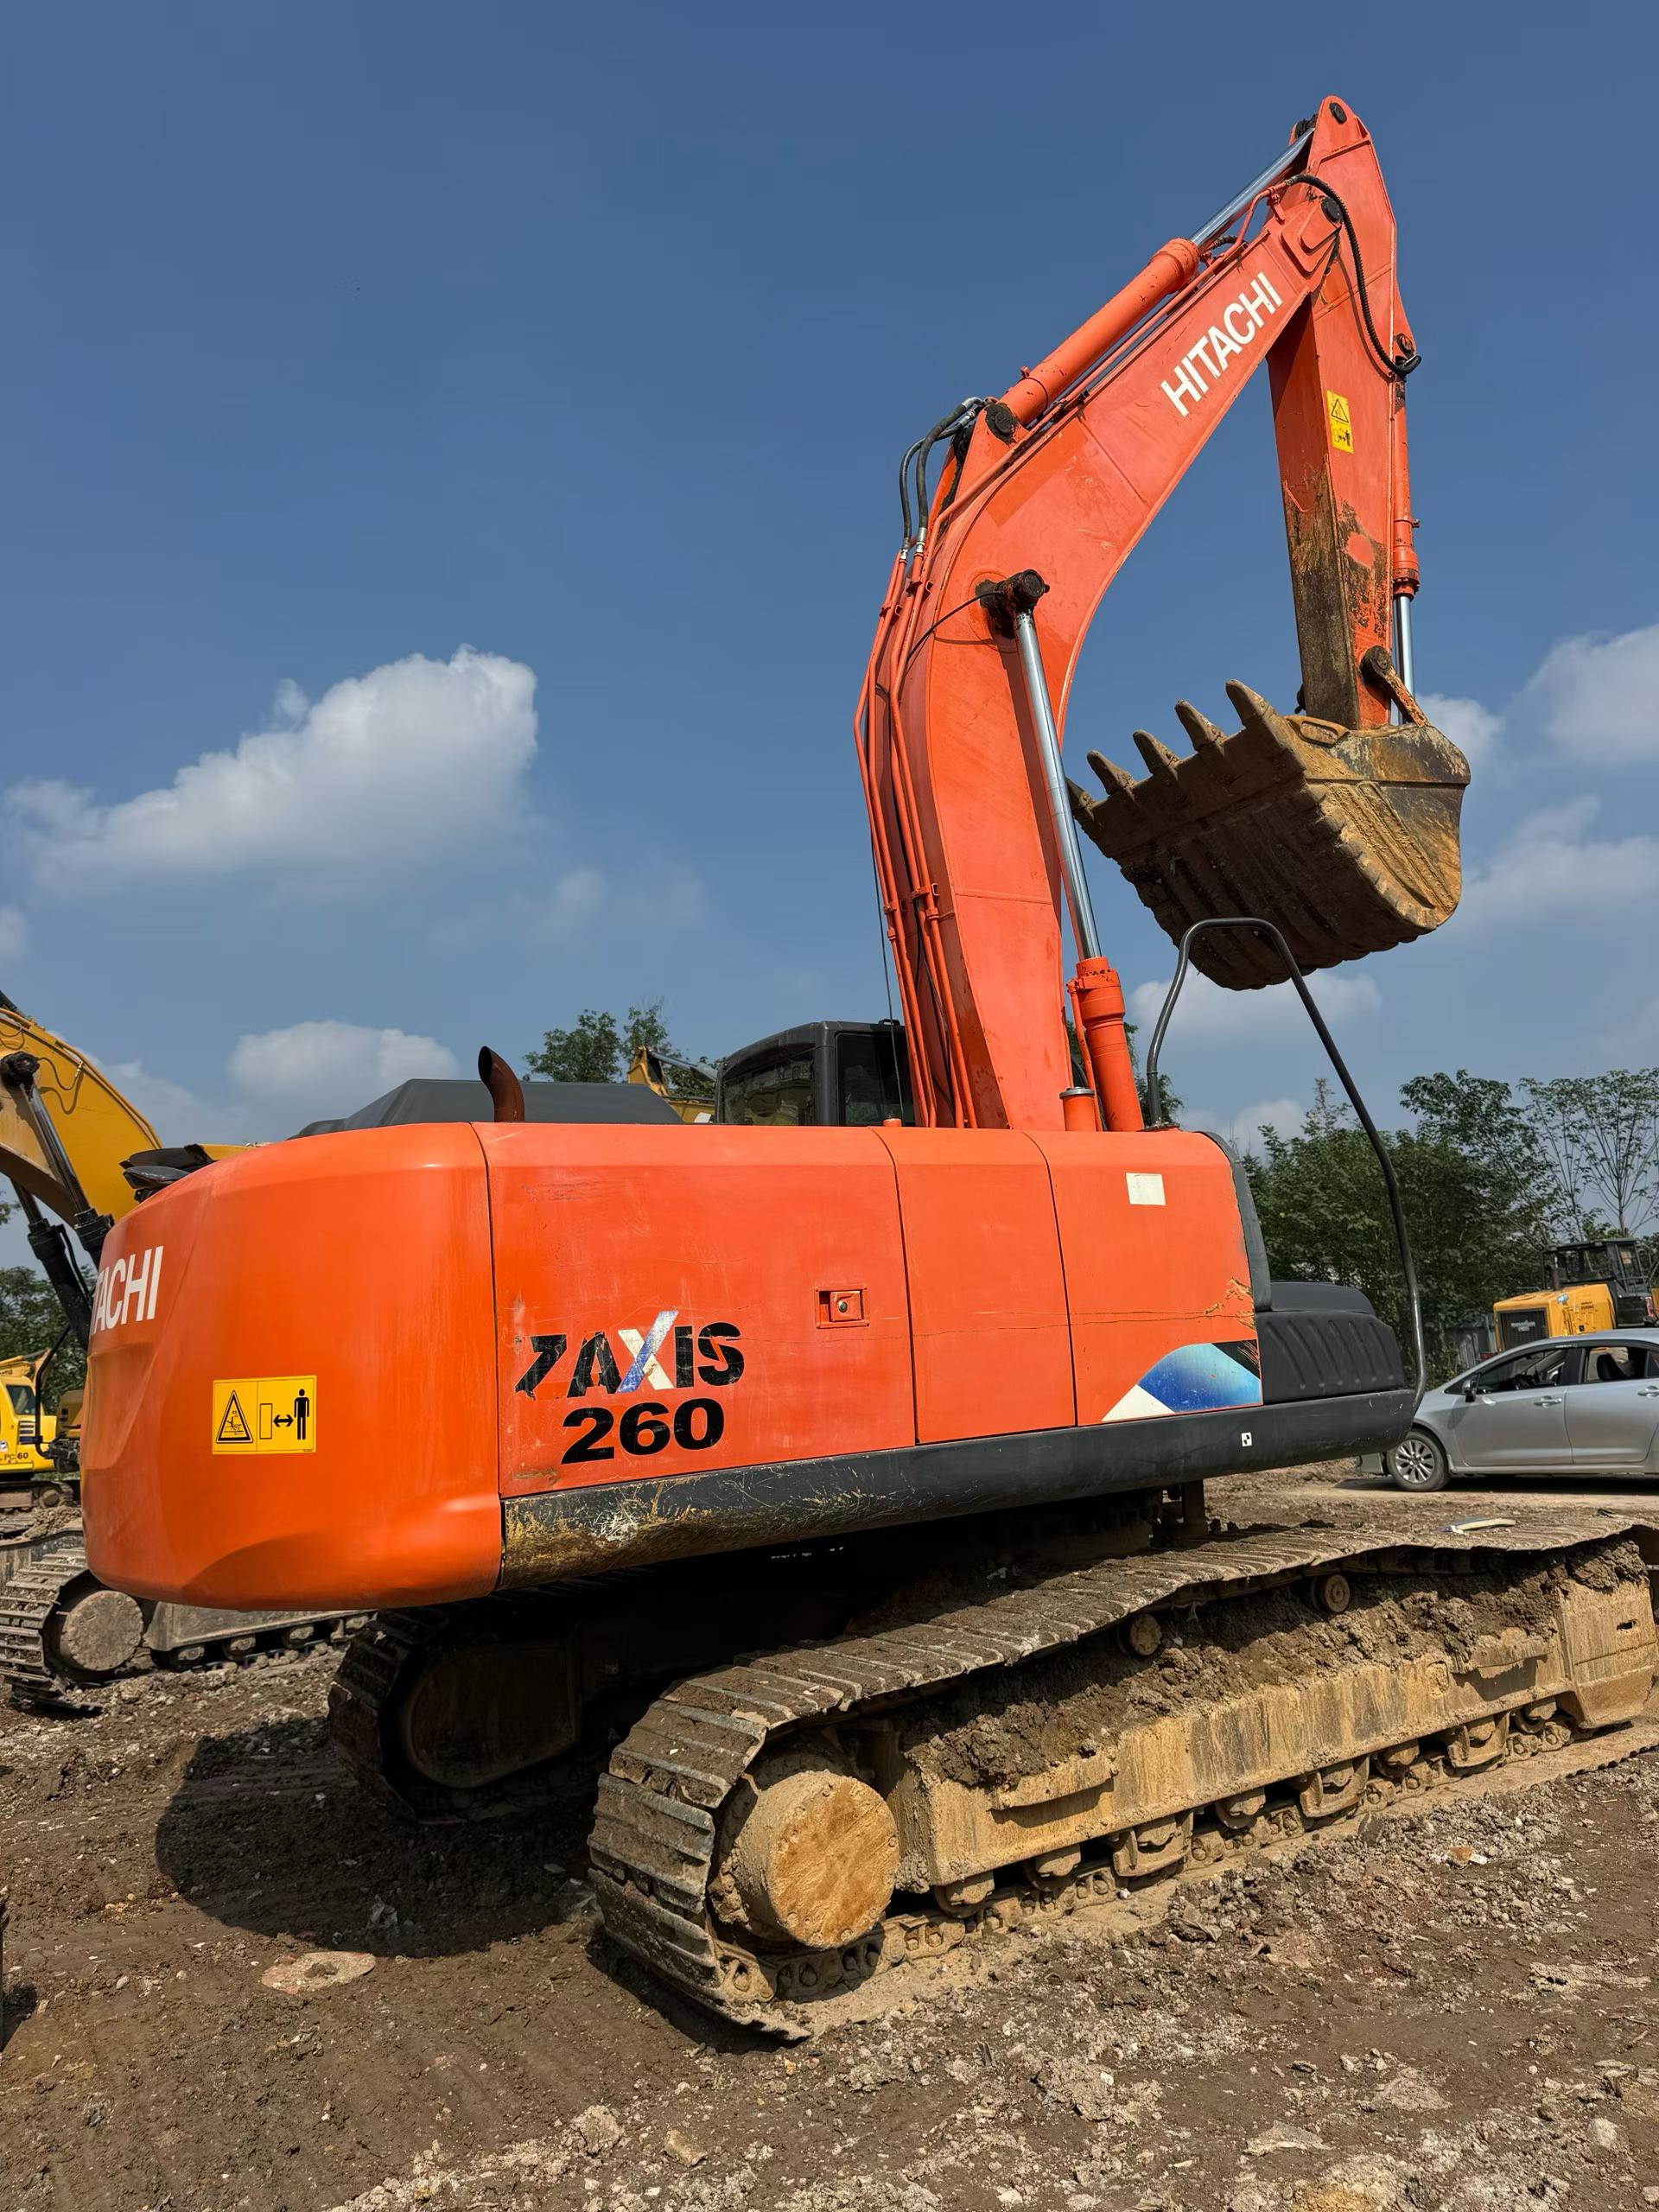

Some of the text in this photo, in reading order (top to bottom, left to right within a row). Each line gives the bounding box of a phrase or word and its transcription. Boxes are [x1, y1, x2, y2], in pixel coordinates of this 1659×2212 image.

[1160, 271, 1283, 417] HITACHI
[514, 1310, 745, 1401] ZAXIS
[561, 1397, 725, 1465] 260
